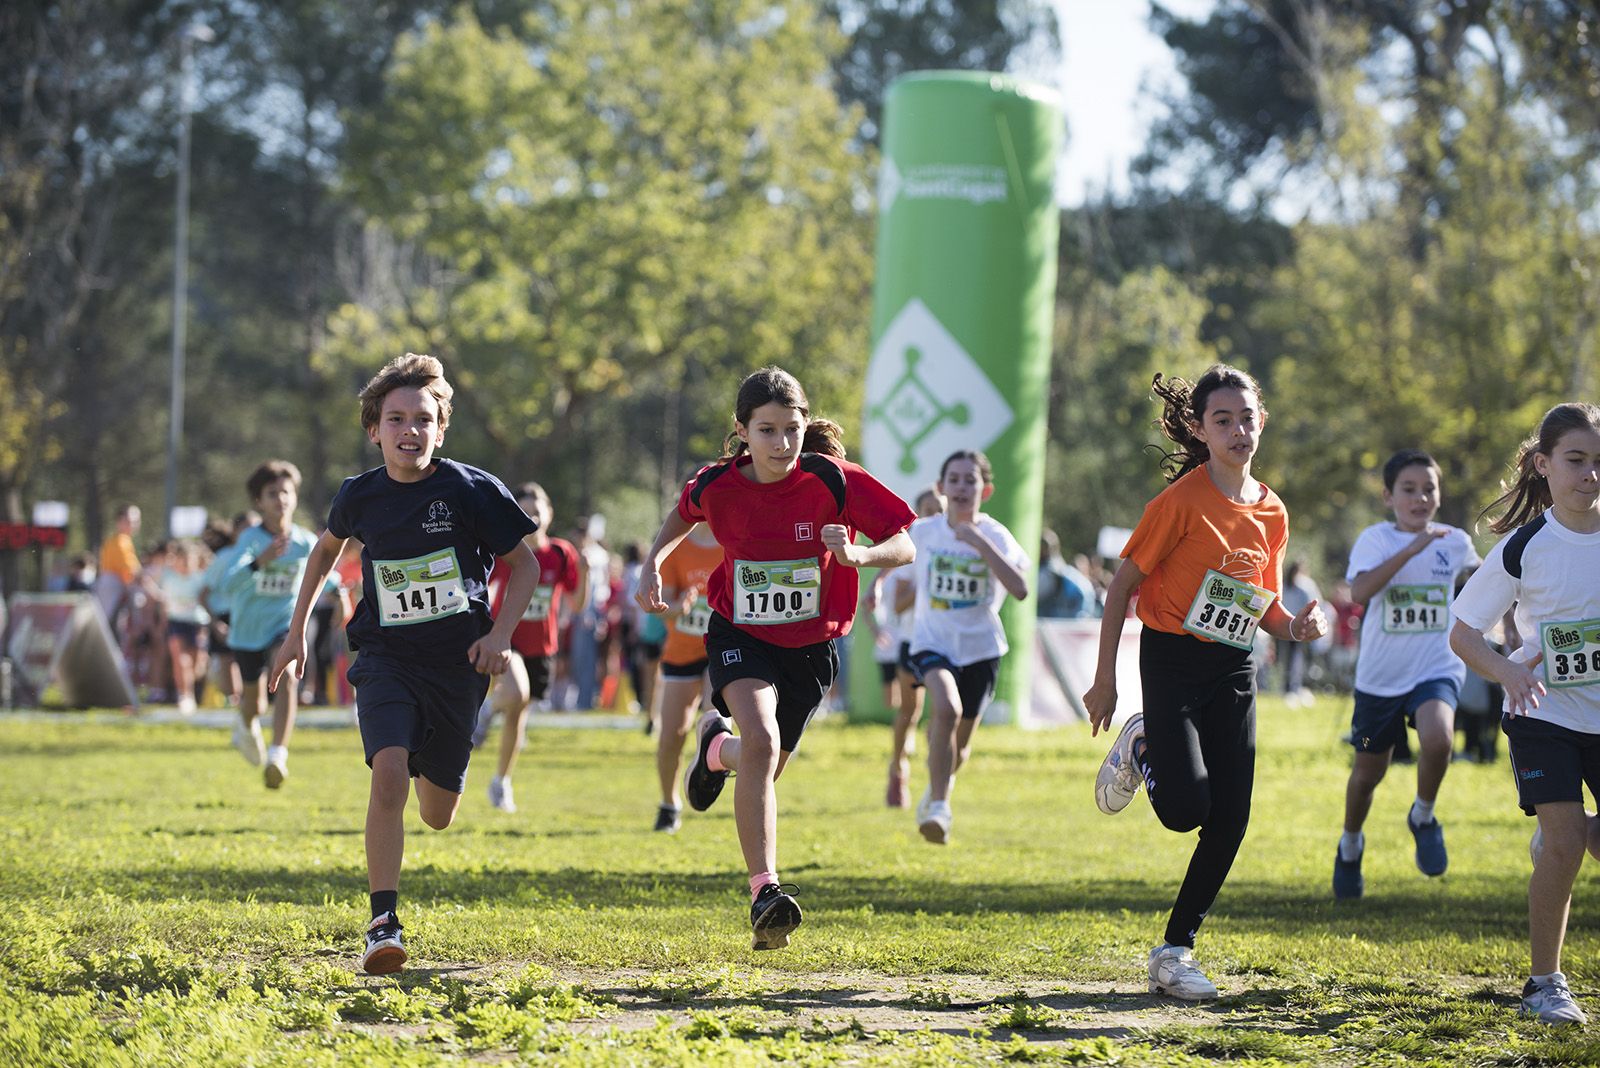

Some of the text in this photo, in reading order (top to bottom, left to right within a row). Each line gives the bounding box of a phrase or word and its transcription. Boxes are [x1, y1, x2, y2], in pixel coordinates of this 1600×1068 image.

[382, 569, 405, 585] CROS
[742, 571, 767, 585] CROS
[396, 586, 437, 612] 147
[1209, 586, 1235, 598] CROS
[746, 591, 803, 613] 1700
[1199, 603, 1251, 636] 3651
[1393, 608, 1437, 624] 3941
[1551, 630, 1580, 647] CROS
